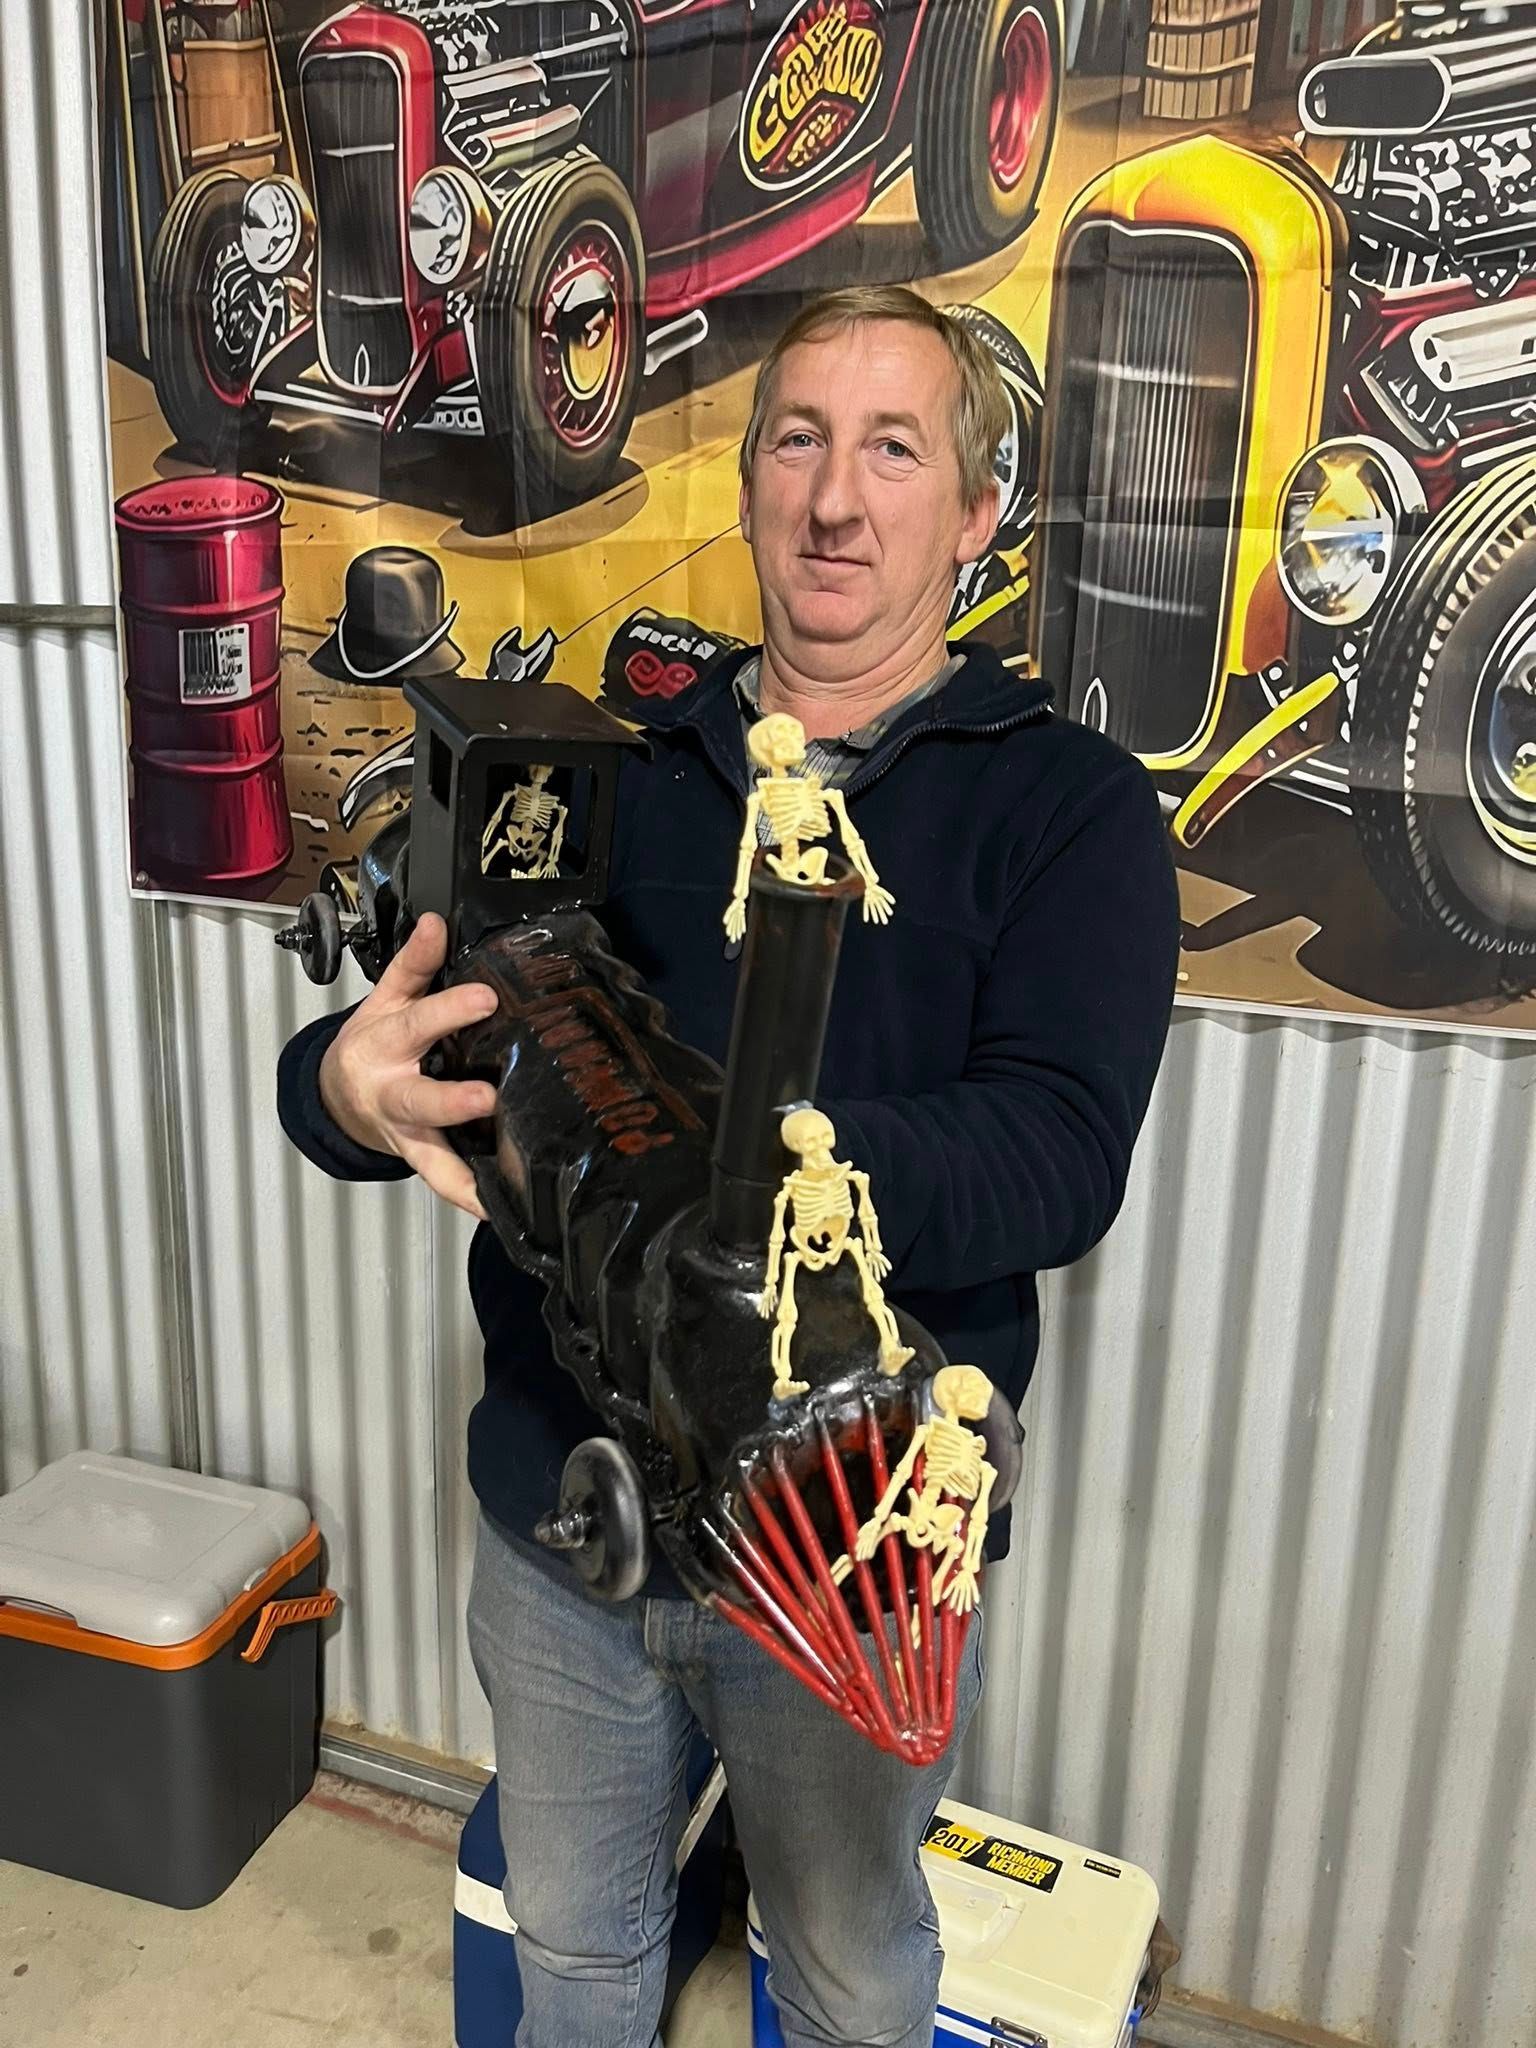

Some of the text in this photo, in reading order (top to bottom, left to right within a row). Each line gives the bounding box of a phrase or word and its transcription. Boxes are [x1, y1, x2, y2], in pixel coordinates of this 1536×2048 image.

[931, 1829, 981, 1856] 2017
[986, 1856, 1045, 1885] MEMBER
[988, 1842, 1056, 1875] RICHMOND
